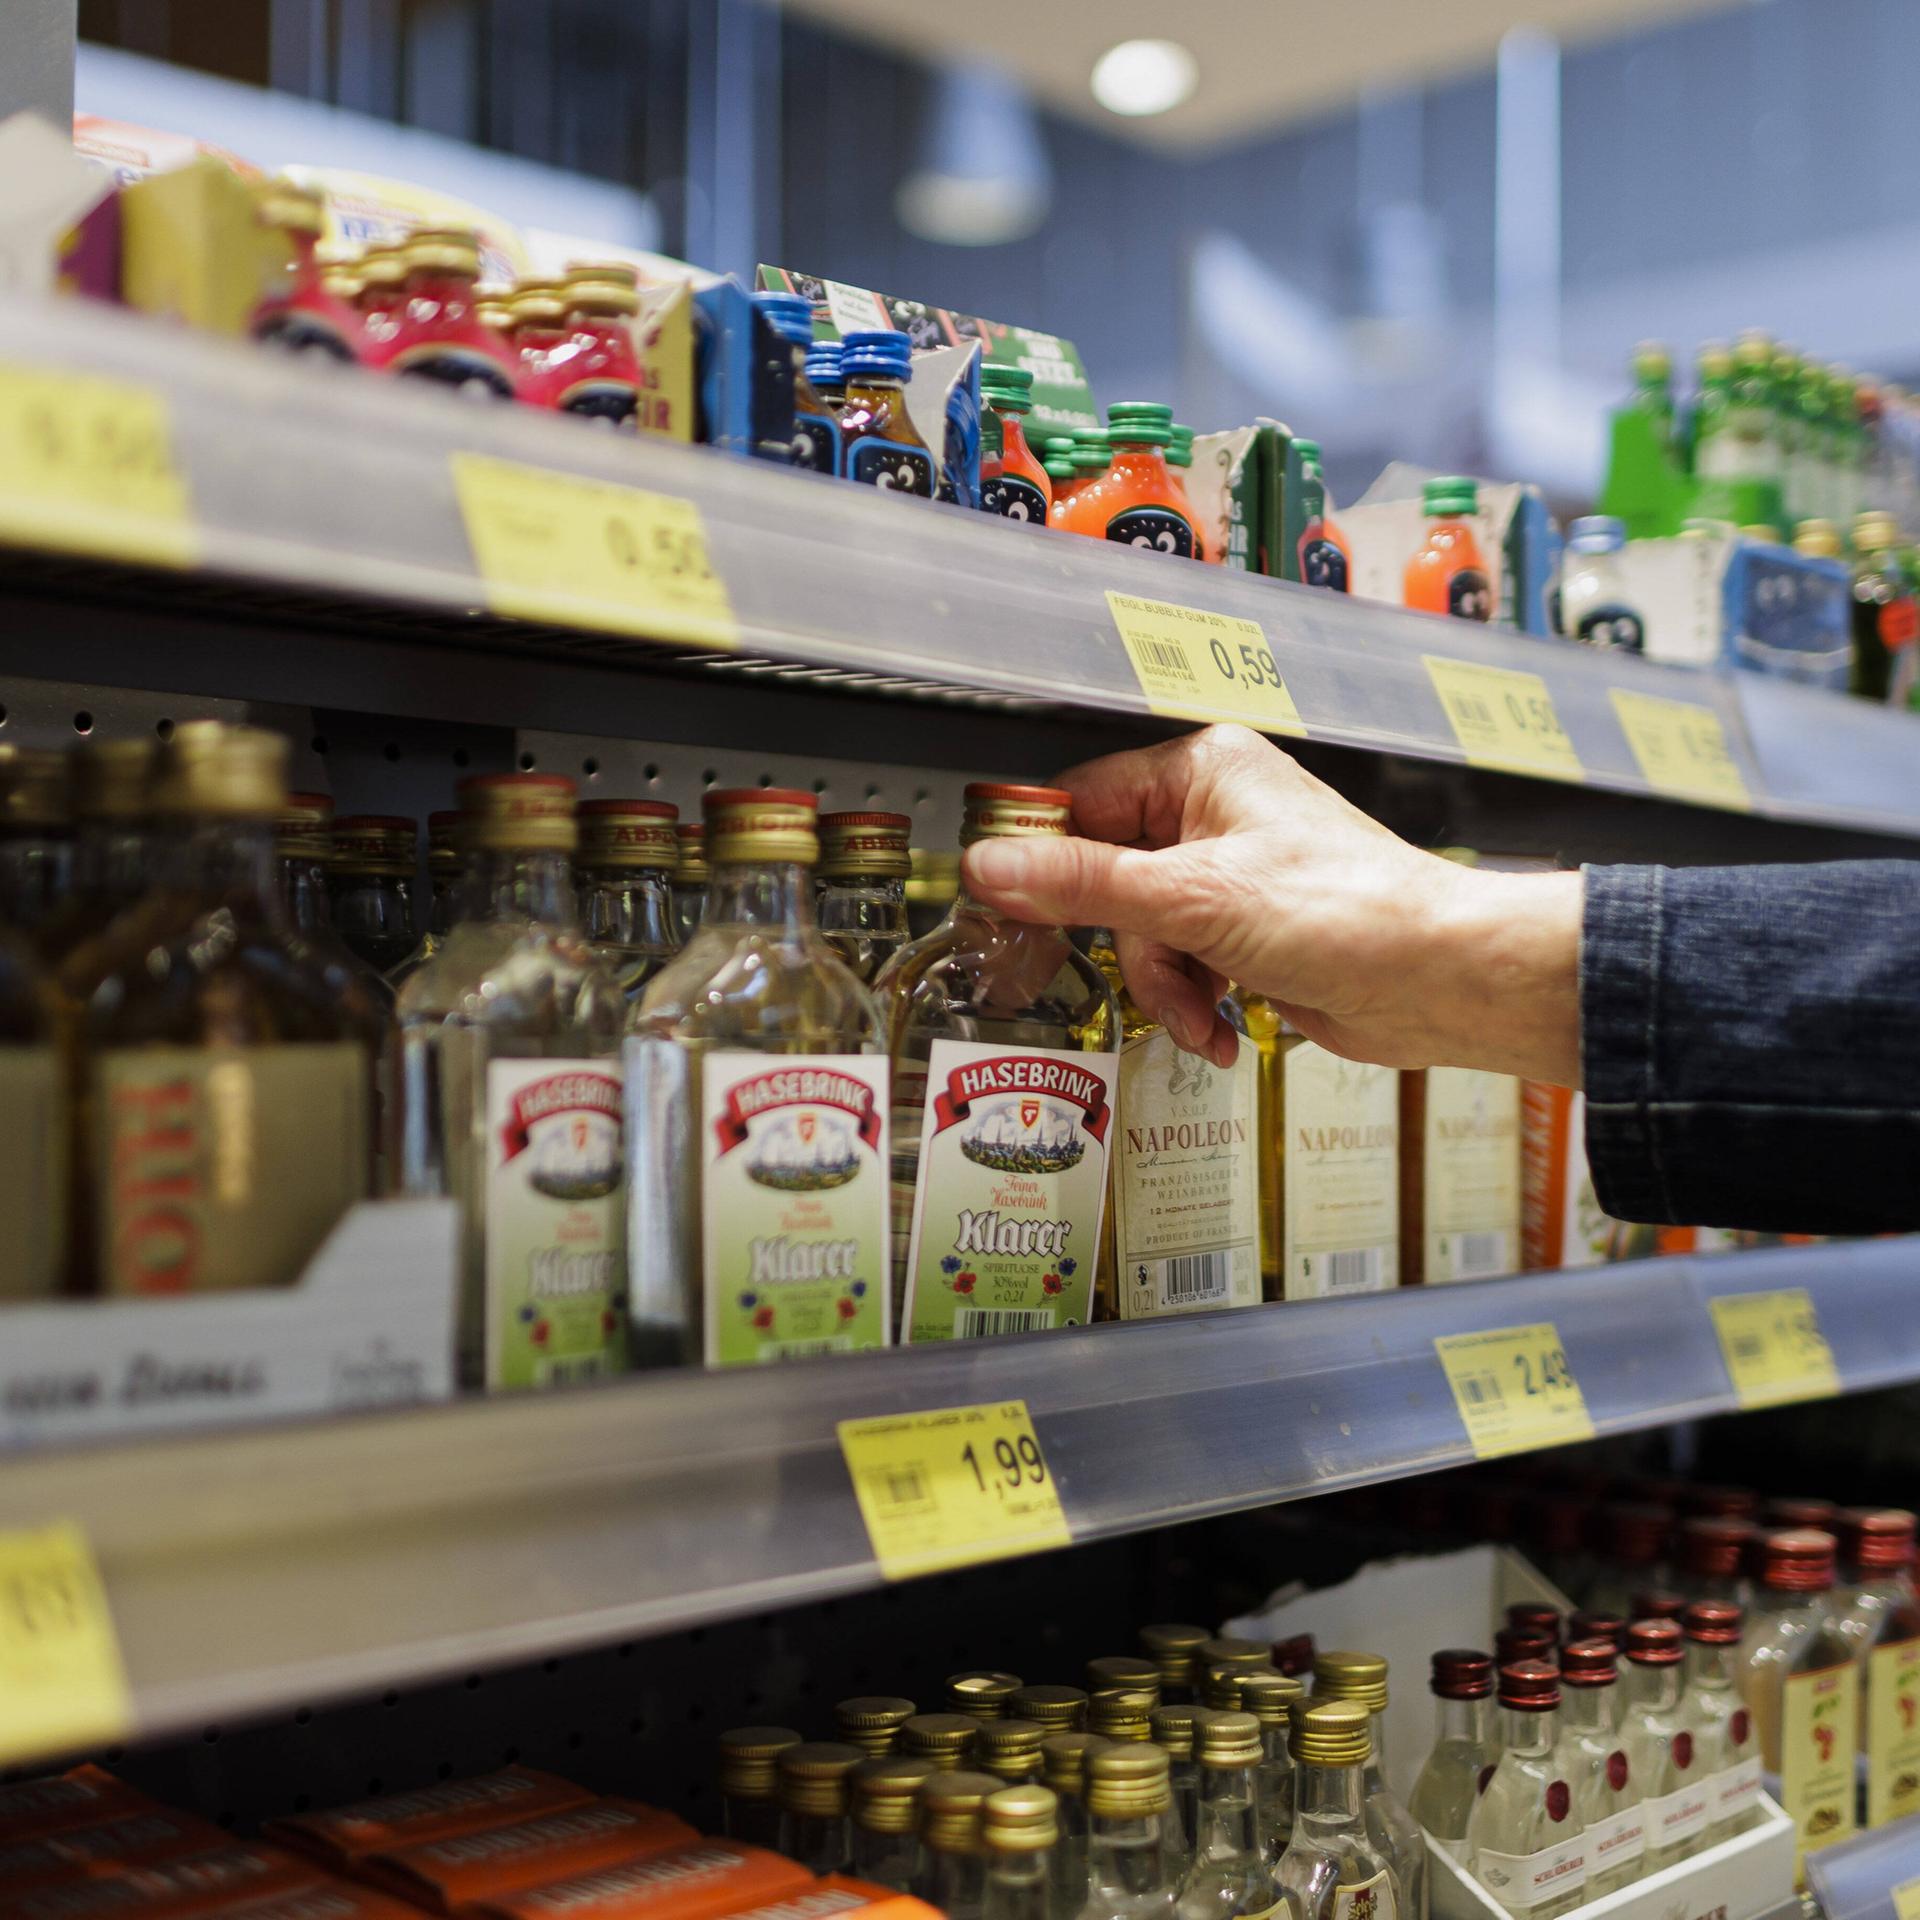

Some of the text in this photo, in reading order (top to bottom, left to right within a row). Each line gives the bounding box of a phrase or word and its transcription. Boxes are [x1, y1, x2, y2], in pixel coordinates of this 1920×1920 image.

[1209, 638, 1284, 690] 0,59
[734, 1069, 869, 1115] HASEBRINK
[960, 1061, 1100, 1105] HASEBRINK
[1126, 1118, 1247, 1155] NAPOLEON
[952, 1208, 1073, 1258] Klarer
[749, 1235, 858, 1284] Klarer
[962, 1434, 1046, 1500] 1,99
